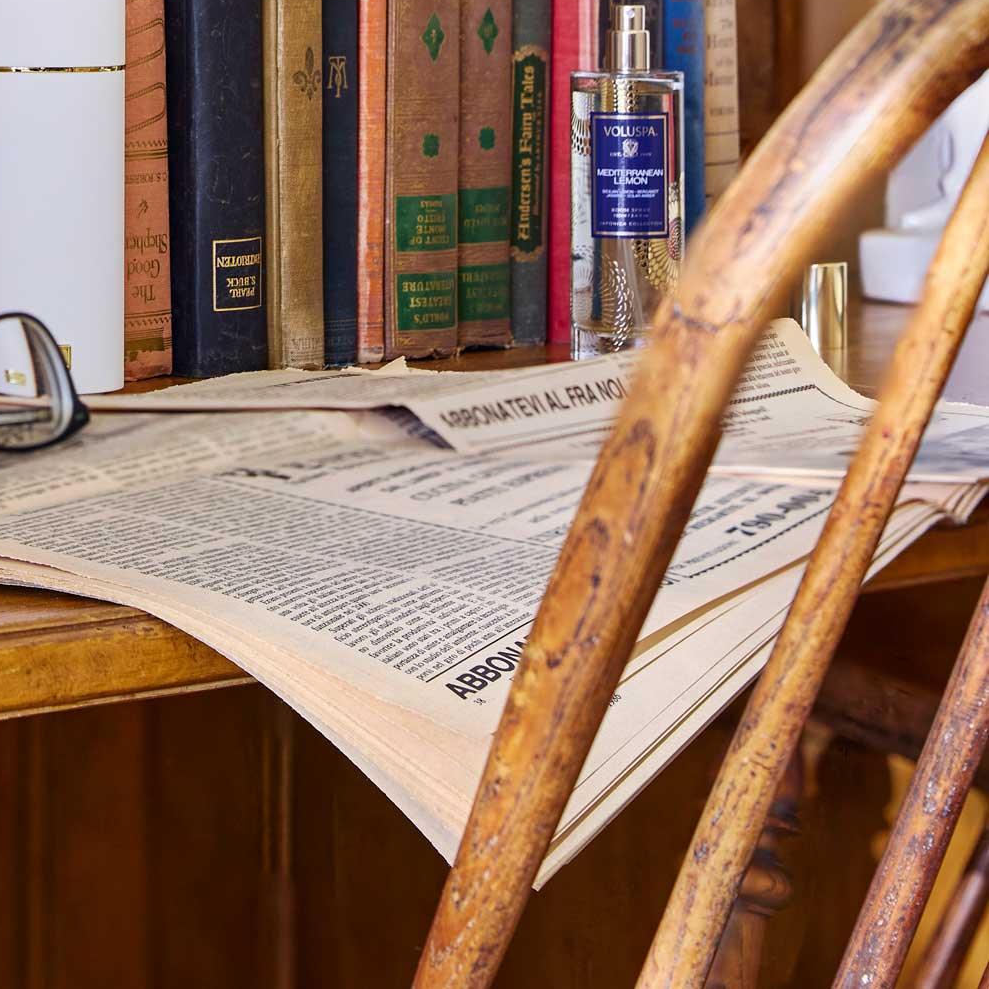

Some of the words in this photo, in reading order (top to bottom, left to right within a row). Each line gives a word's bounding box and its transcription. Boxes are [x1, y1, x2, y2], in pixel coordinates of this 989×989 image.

[521, 65, 535, 110] Tales
[603, 125, 656, 137] VOLUSPA
[596, 168, 664, 177] MEDITERRANEAN
[613, 176, 648, 185] LEMON
[131, 284, 156, 303] The
[228, 288, 256, 299] PEARL
[543, 389, 570, 412] AL
[565, 383, 601, 407] FRA
[596, 376, 628, 401] NOI
[370, 626, 404, 646] dimostrato
[401, 640, 419, 651] sono
[393, 651, 420, 671] portanza
